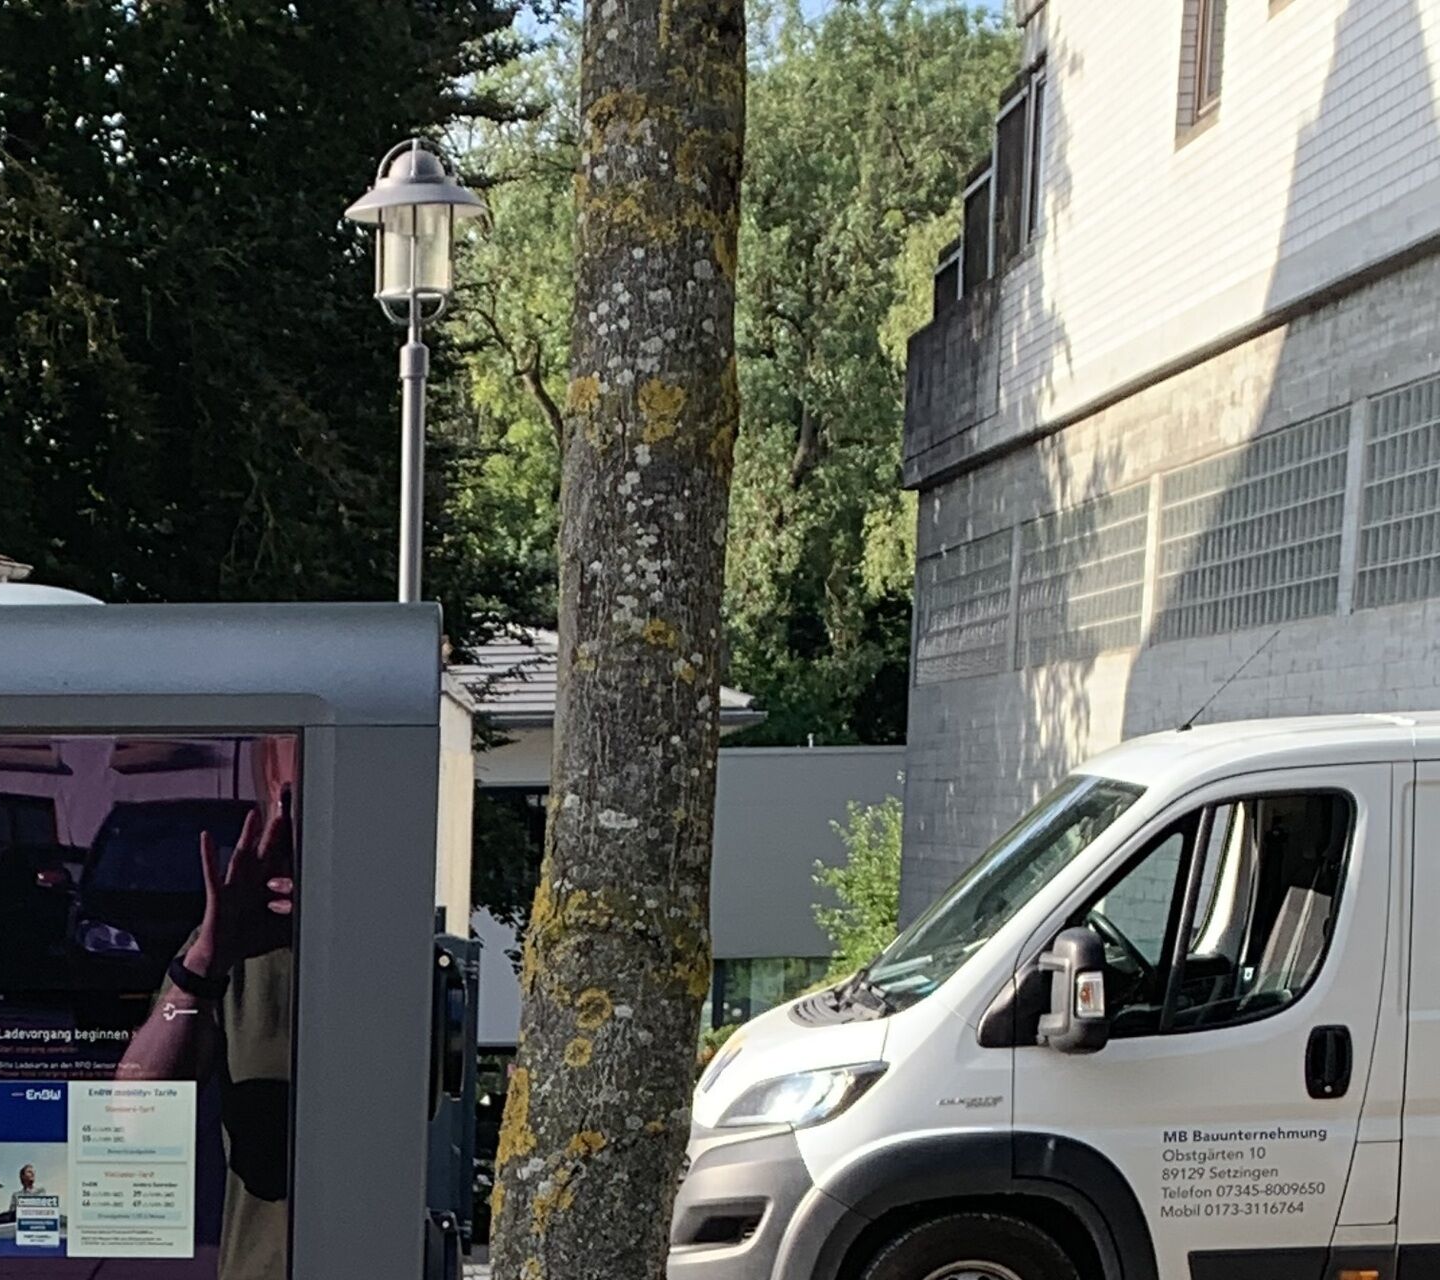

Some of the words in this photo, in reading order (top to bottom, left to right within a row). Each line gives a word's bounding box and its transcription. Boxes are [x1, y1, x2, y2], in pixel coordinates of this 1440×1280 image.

[75, 1028, 129, 1042] beginnen
[26, 1089, 61, 1100] EnBW
[1163, 1130, 1187, 1143] MB
[1193, 1127, 1328, 1143] Bauunternehmung
[1162, 1148, 1244, 1164] Obstgärten
[1250, 1147, 1266, 1160] 10
[1162, 1167, 1206, 1181] 89129
[1210, 1166, 1279, 1181] Setzingen
[1162, 1186, 1212, 1199] Telefon
[1216, 1182, 1326, 1198] 07345-8009650
[1160, 1203, 1200, 1218] Mobil
[1204, 1201, 1304, 1216] 0173-3116764
